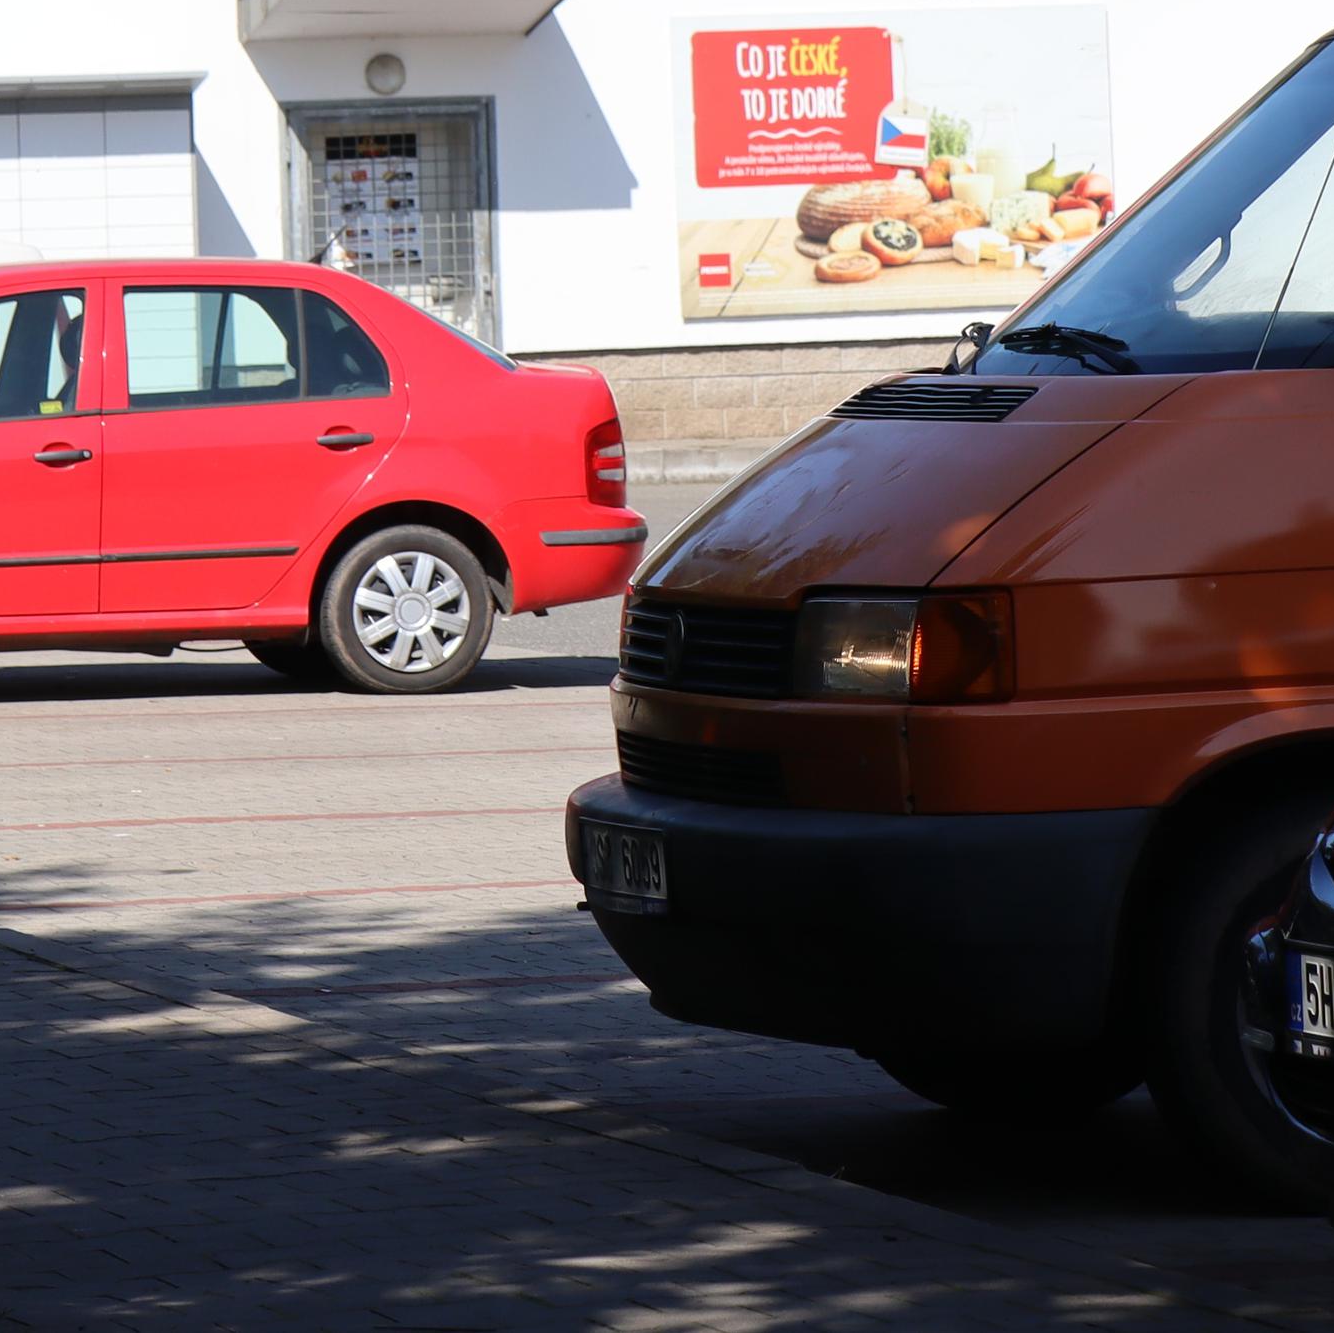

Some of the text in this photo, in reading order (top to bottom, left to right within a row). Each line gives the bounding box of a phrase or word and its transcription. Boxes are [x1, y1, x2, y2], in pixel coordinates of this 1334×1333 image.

[765, 44, 787, 81] JE
[789, 35, 848, 78] ČESKÉ,
[740, 78, 848, 124] TO JE DOBRÉ
